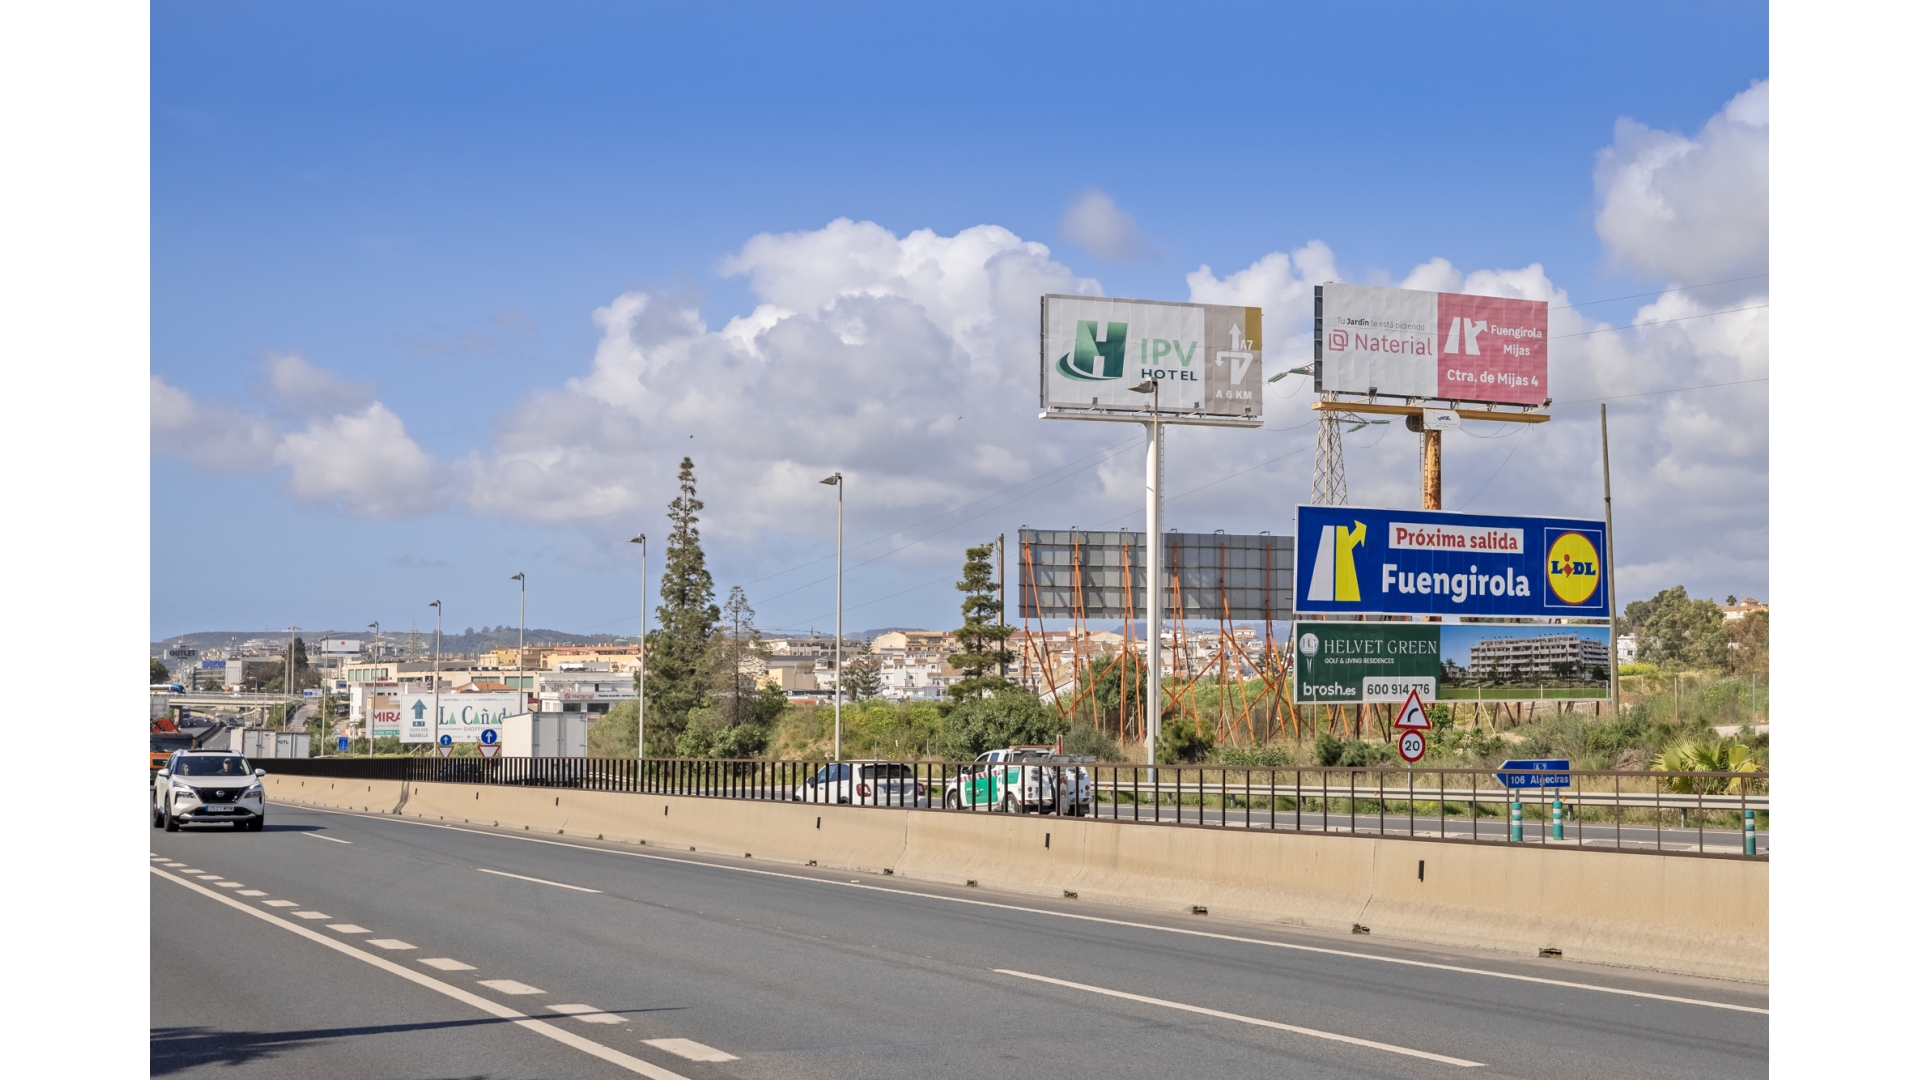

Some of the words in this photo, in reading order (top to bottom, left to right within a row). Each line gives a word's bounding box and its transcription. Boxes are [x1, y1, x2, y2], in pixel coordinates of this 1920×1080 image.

[1336, 316, 1346, 324] Tu
[1370, 320, 1378, 328] te
[1379, 320, 1394, 328] está
[1396, 322, 1426, 331] pidiendo
[1490, 324, 1542, 340] Fuengirola
[1240, 339, 1253, 350] A7
[1355, 332, 1432, 356] Naterial
[1503, 344, 1530, 357] Mijas
[1142, 338, 1198, 367] IPV
[1142, 368, 1198, 381] HOTEL
[1447, 369, 1477, 382] Ctra.
[1480, 370, 1495, 384] de
[1497, 372, 1529, 387] Mijas
[1531, 376, 1539, 387] 4
[1216, 390, 1222, 398] A
[1226, 390, 1232, 400] 6
[1236, 390, 1252, 400] KM
[1396, 527, 1466, 548] Próxima
[1470, 530, 1518, 551] salida
[1382, 563, 1531, 604] Fuengirola
[1324, 640, 1384, 654] HELVET
[1387, 640, 1437, 654] GREEN
[1303, 682, 1356, 696] brosh.es
[1367, 684, 1388, 695] 600
[1391, 684, 1409, 695] 914
[461, 706, 512, 725] Cañad
[1405, 740, 1420, 752] 20
[1511, 776, 1526, 784] 106
[1530, 775, 1569, 786] Algeciras
